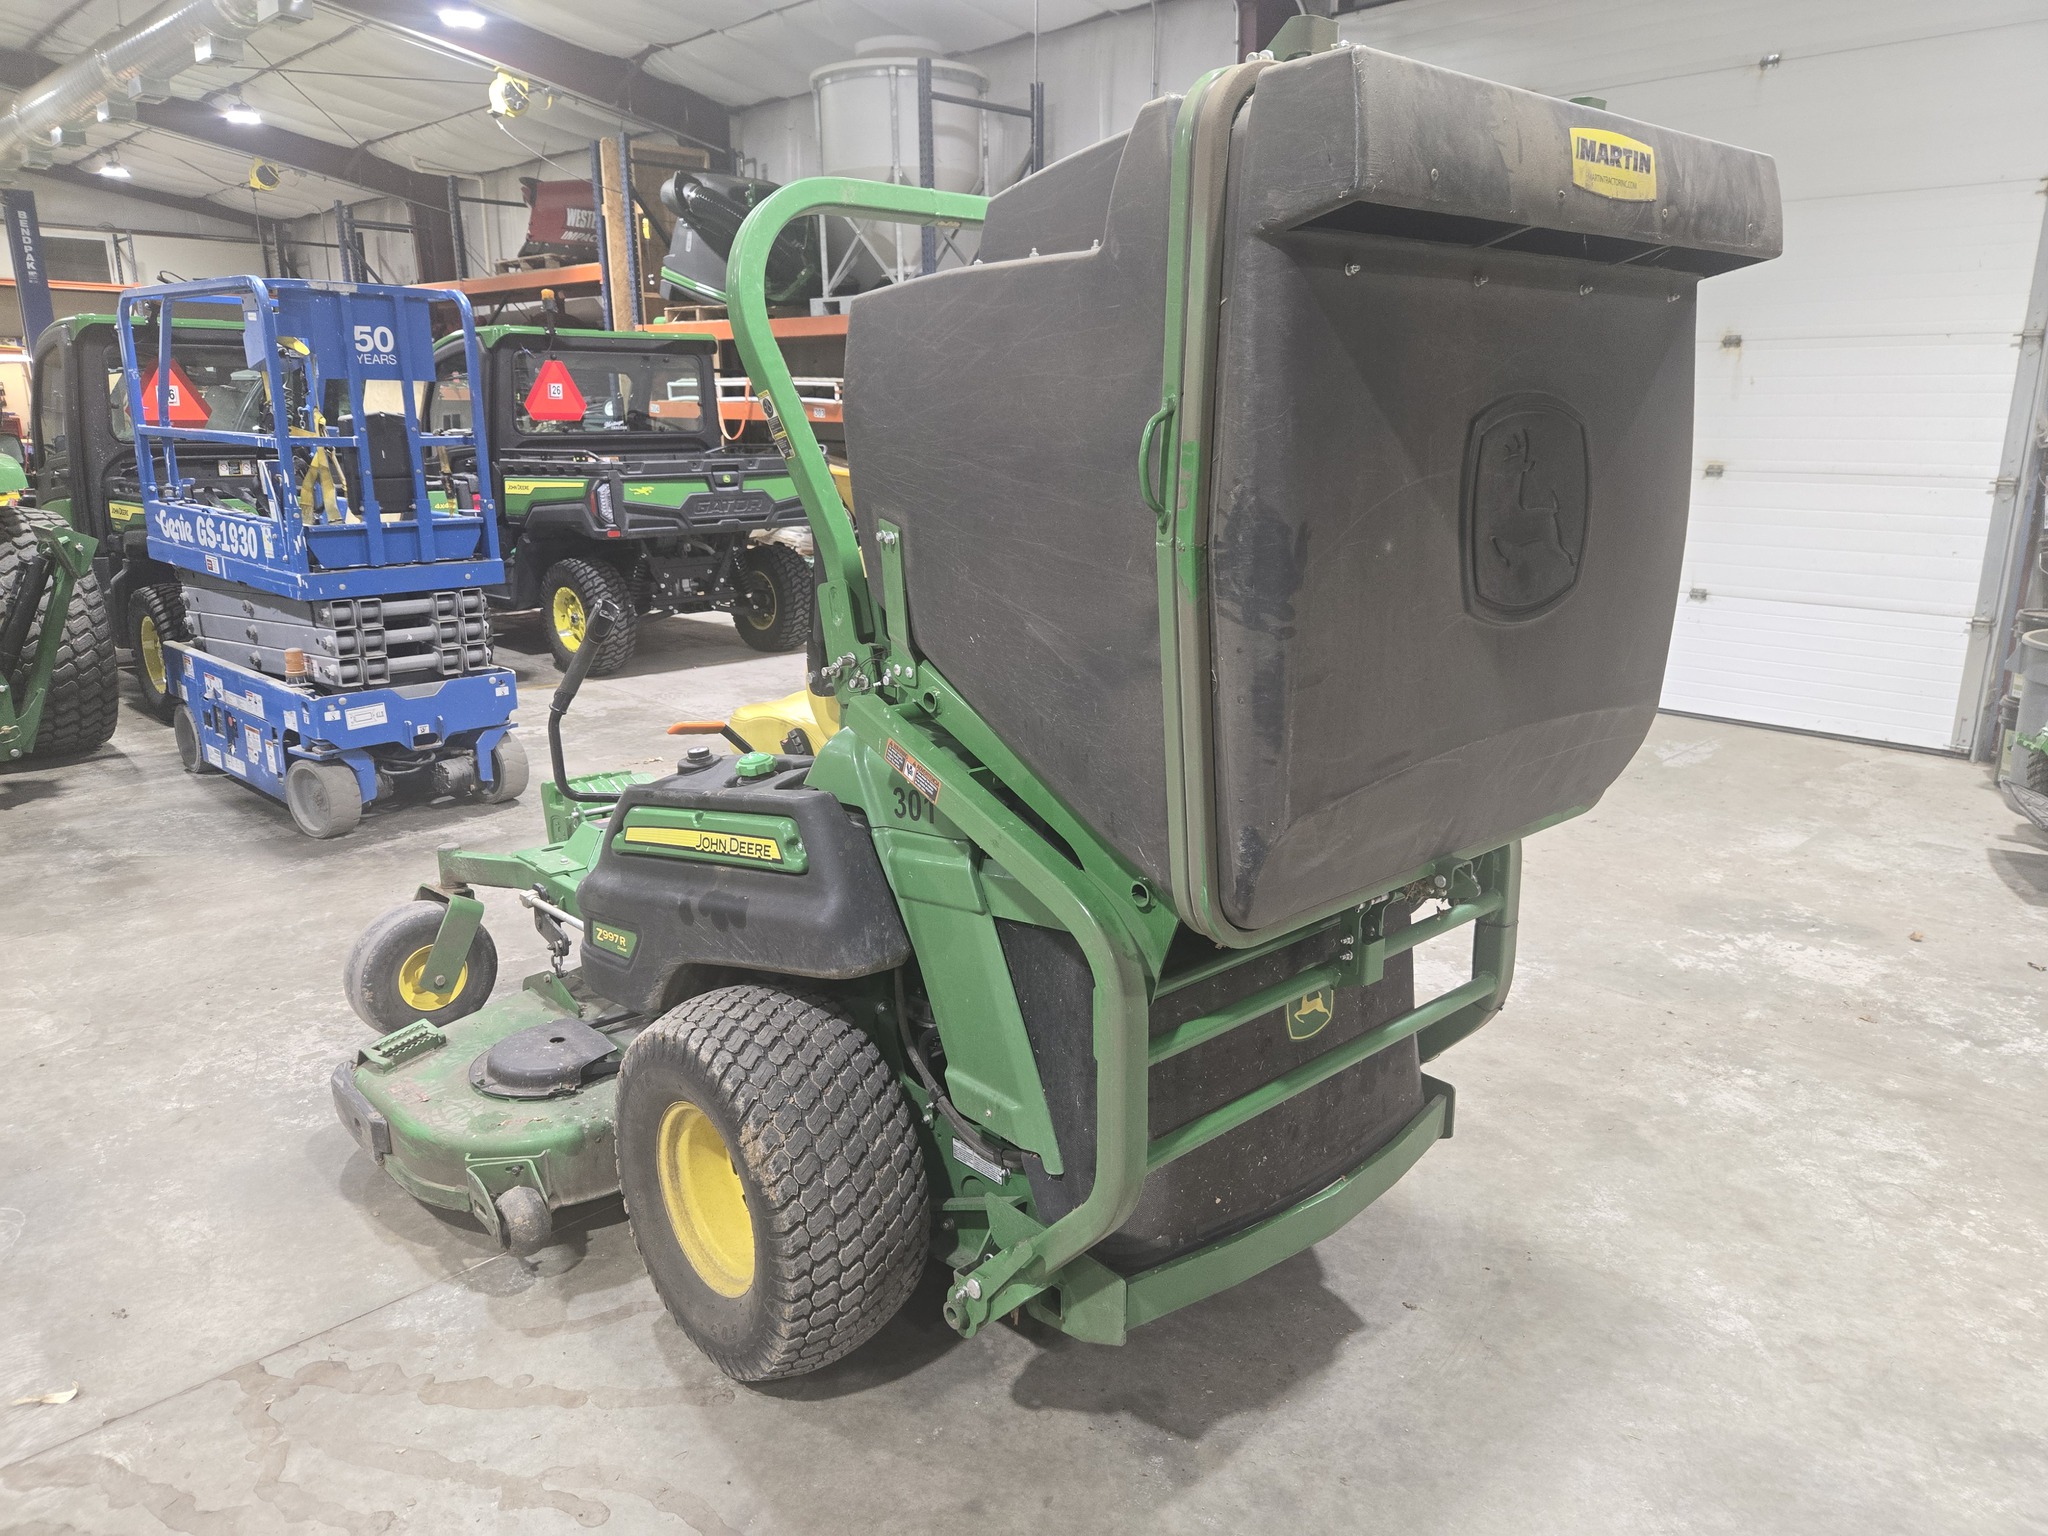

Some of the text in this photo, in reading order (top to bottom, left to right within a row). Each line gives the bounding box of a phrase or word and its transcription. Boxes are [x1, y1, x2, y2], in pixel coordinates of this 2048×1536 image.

[1576, 137, 1651, 174] MARTIN
[17, 210, 36, 270] BENDPAK
[353, 325, 394, 353] 50
[356, 353, 397, 365] YEARS
[552, 385, 561, 395] 26
[694, 500, 762, 514] GATOR
[155, 509, 195, 544] Genie
[196, 516, 258, 560] GS-1930
[893, 786, 934, 824] 301
[695, 834, 772, 858] JOHN DEERE
